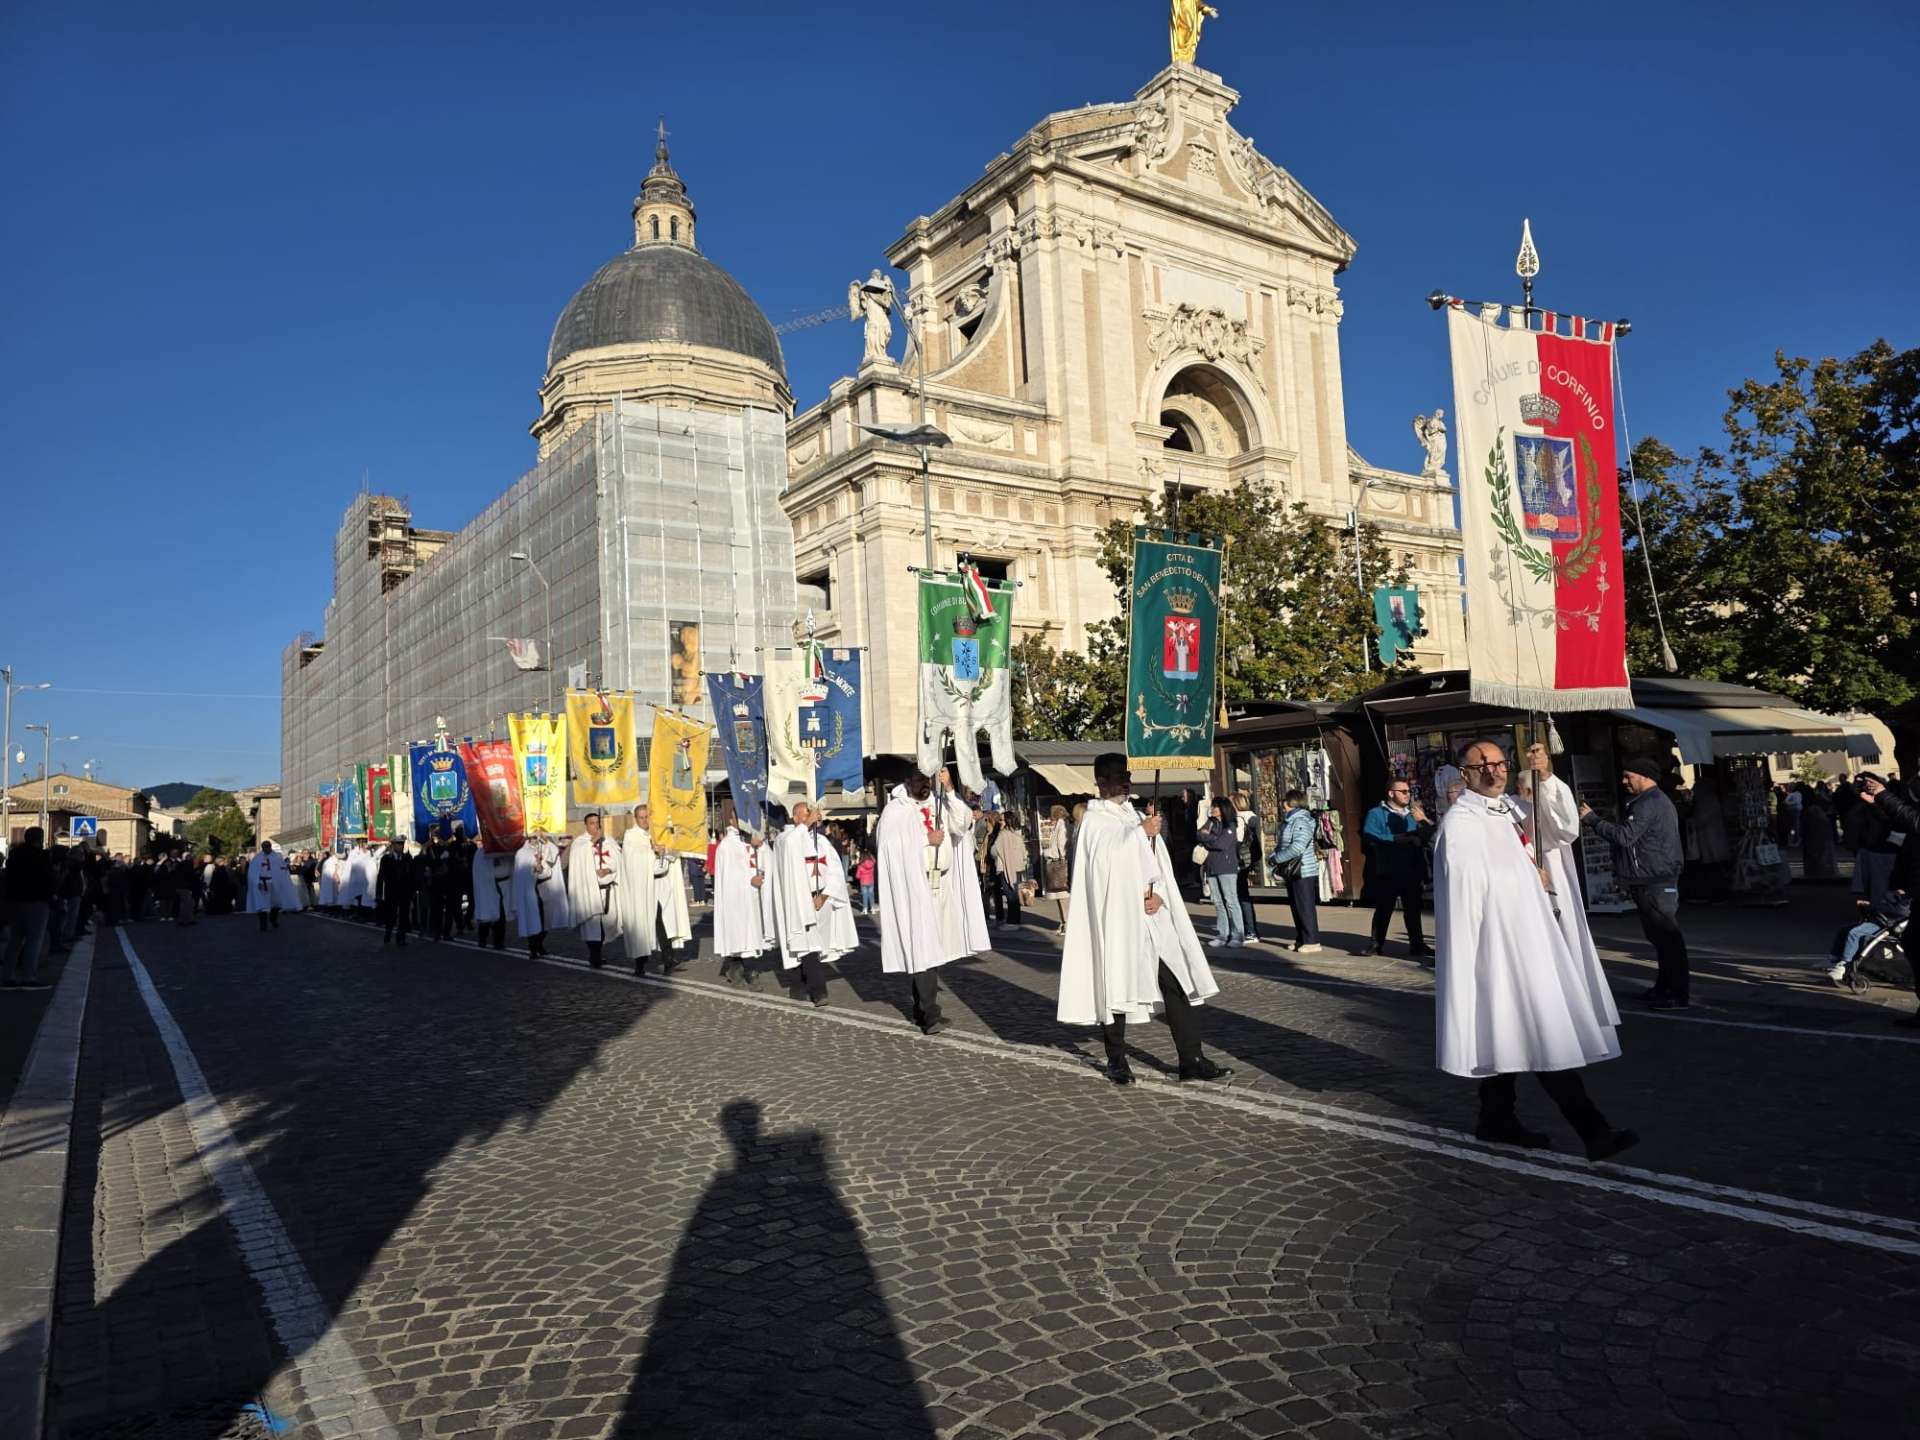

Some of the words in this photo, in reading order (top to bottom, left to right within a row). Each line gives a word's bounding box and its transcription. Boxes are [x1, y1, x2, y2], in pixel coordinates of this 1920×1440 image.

[1547, 364, 1605, 430] CORFINIO
[1136, 580, 1151, 597] SAN
[1149, 566, 1193, 584] BENEDETTO
